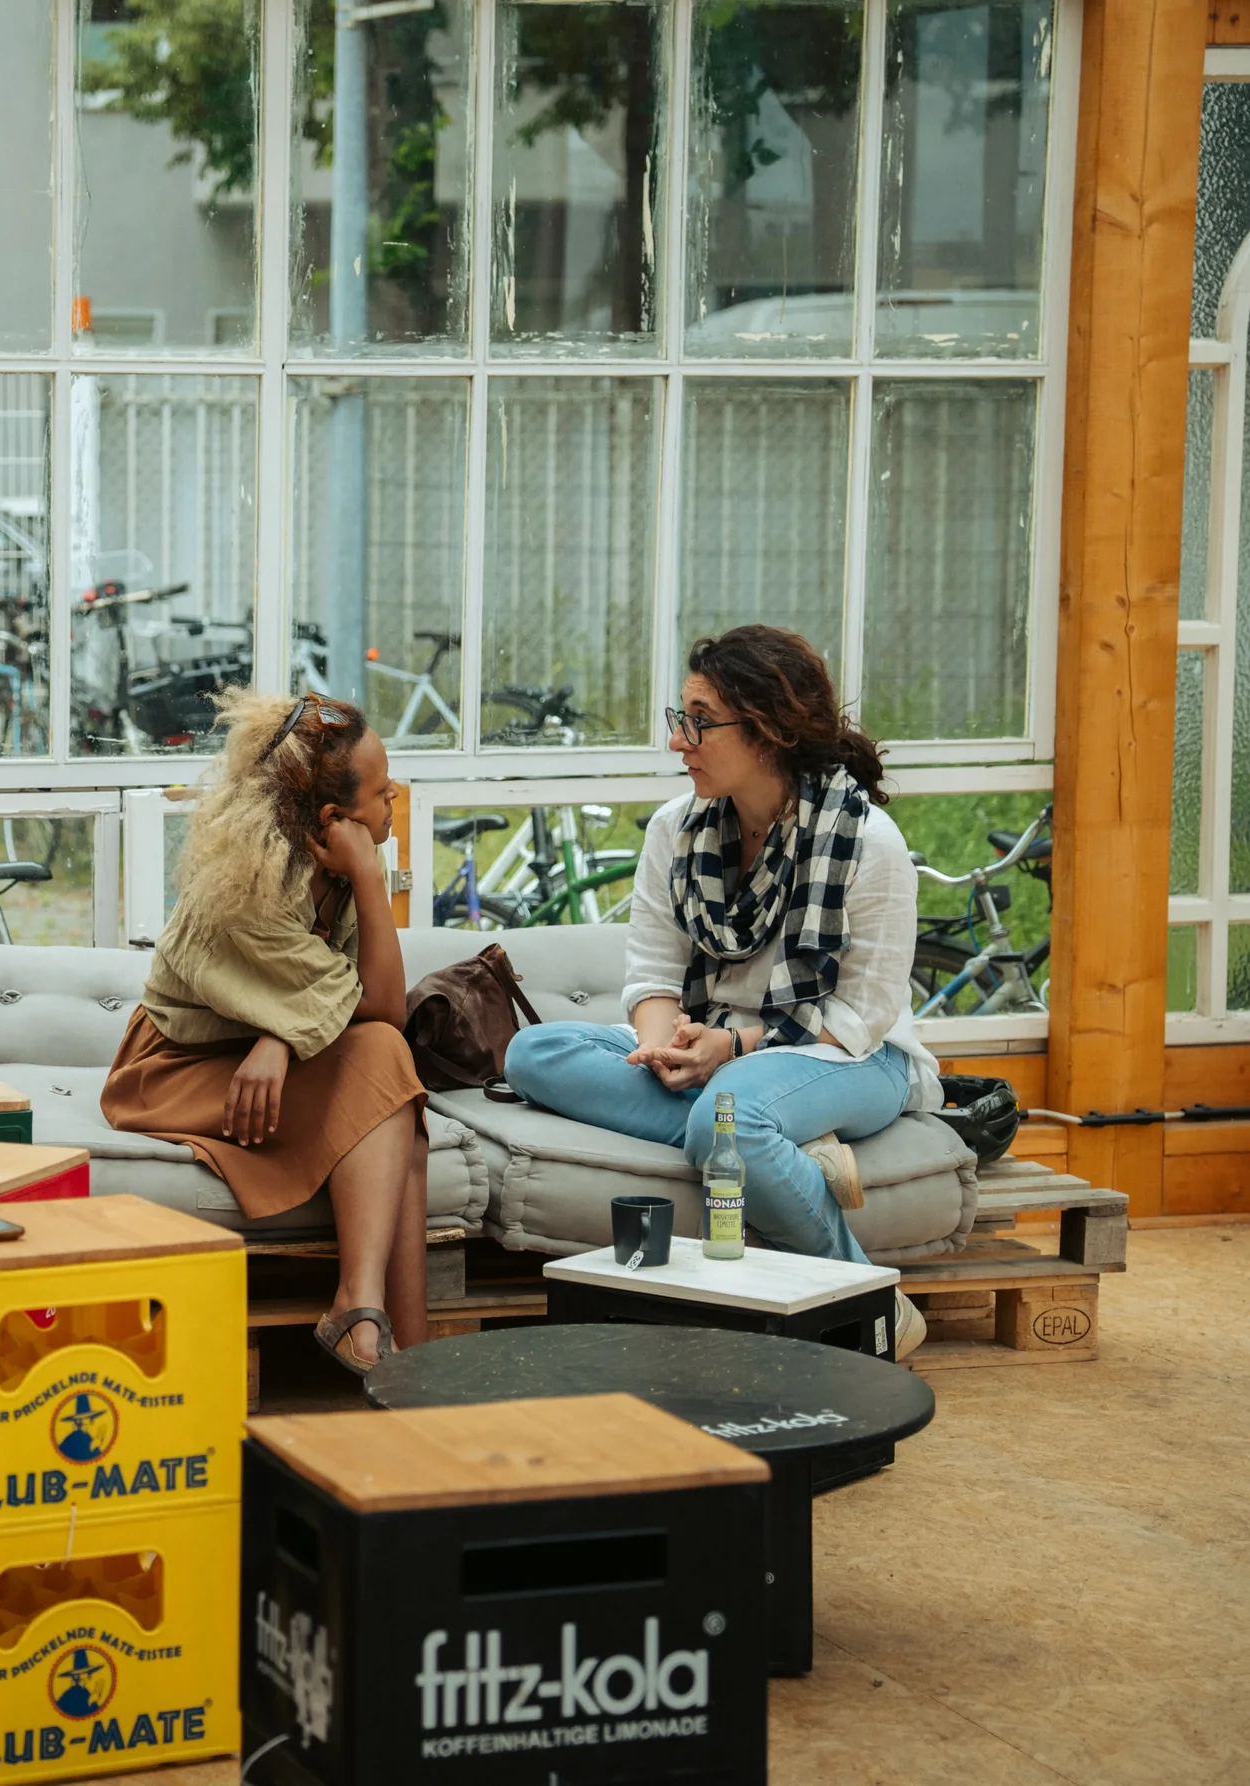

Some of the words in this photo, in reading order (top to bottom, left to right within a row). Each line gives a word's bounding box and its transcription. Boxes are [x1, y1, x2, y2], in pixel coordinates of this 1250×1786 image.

[717, 1113, 734, 1122] BIO
[705, 1197, 745, 1208] BIONADE
[1042, 1315, 1082, 1336] EPAL
[13, 1372, 98, 1421] PRICKELNDE
[102, 1377, 184, 1408] MATE-EISTEE
[11, 1627, 96, 1677] PRICKELNDE
[100, 1631, 182, 1661] MATE-EISTEE
[415, 1616, 709, 1729] fritz-kola
[422, 1723, 599, 1758] KOFFEINHALTIGE
[603, 1715, 708, 1743] LIMONADE
